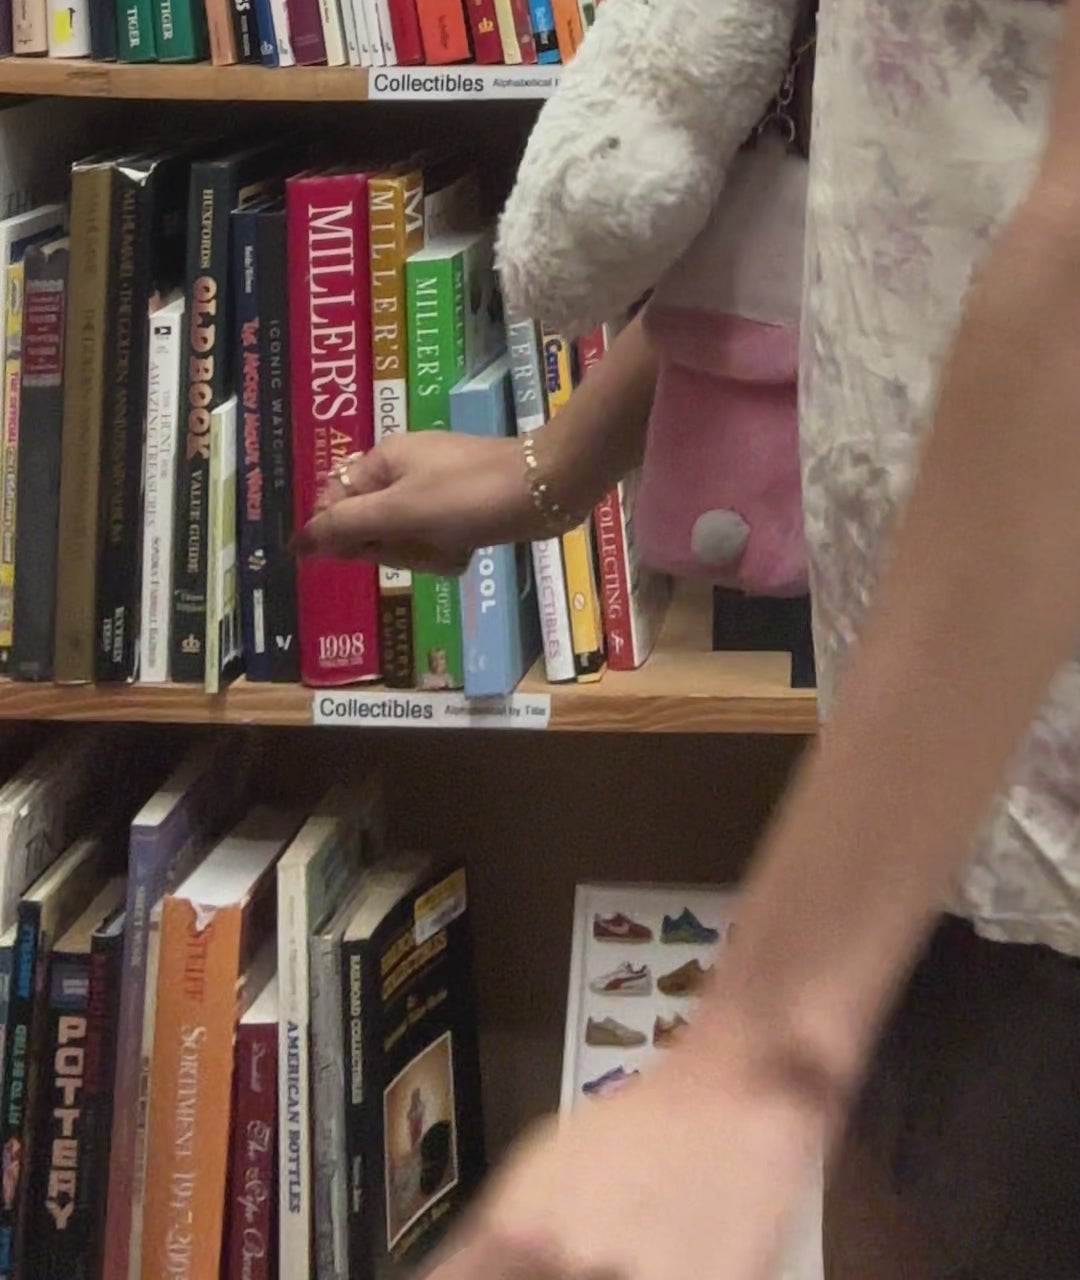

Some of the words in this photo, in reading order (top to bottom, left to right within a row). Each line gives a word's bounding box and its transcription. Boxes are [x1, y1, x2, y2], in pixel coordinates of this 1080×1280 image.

[126, 5, 141, 48] TIGER
[160, 0, 174, 41] TIGER
[374, 73, 484, 93] Collectibles
[370, 189, 400, 372] MILLER'S
[308, 200, 359, 421] MILLER'S
[415, 277, 440, 397] MILLER'S
[188, 469, 203, 520] VALUE
[187, 523, 201, 574] GUIDE
[318, 633, 366, 658] 1998
[319, 697, 434, 720] Collectibles
[287, 1021, 301, 1123] AMERICAN
[45, 1016, 88, 1230] POTTERY
[288, 1128, 301, 1214] BOTTLES
